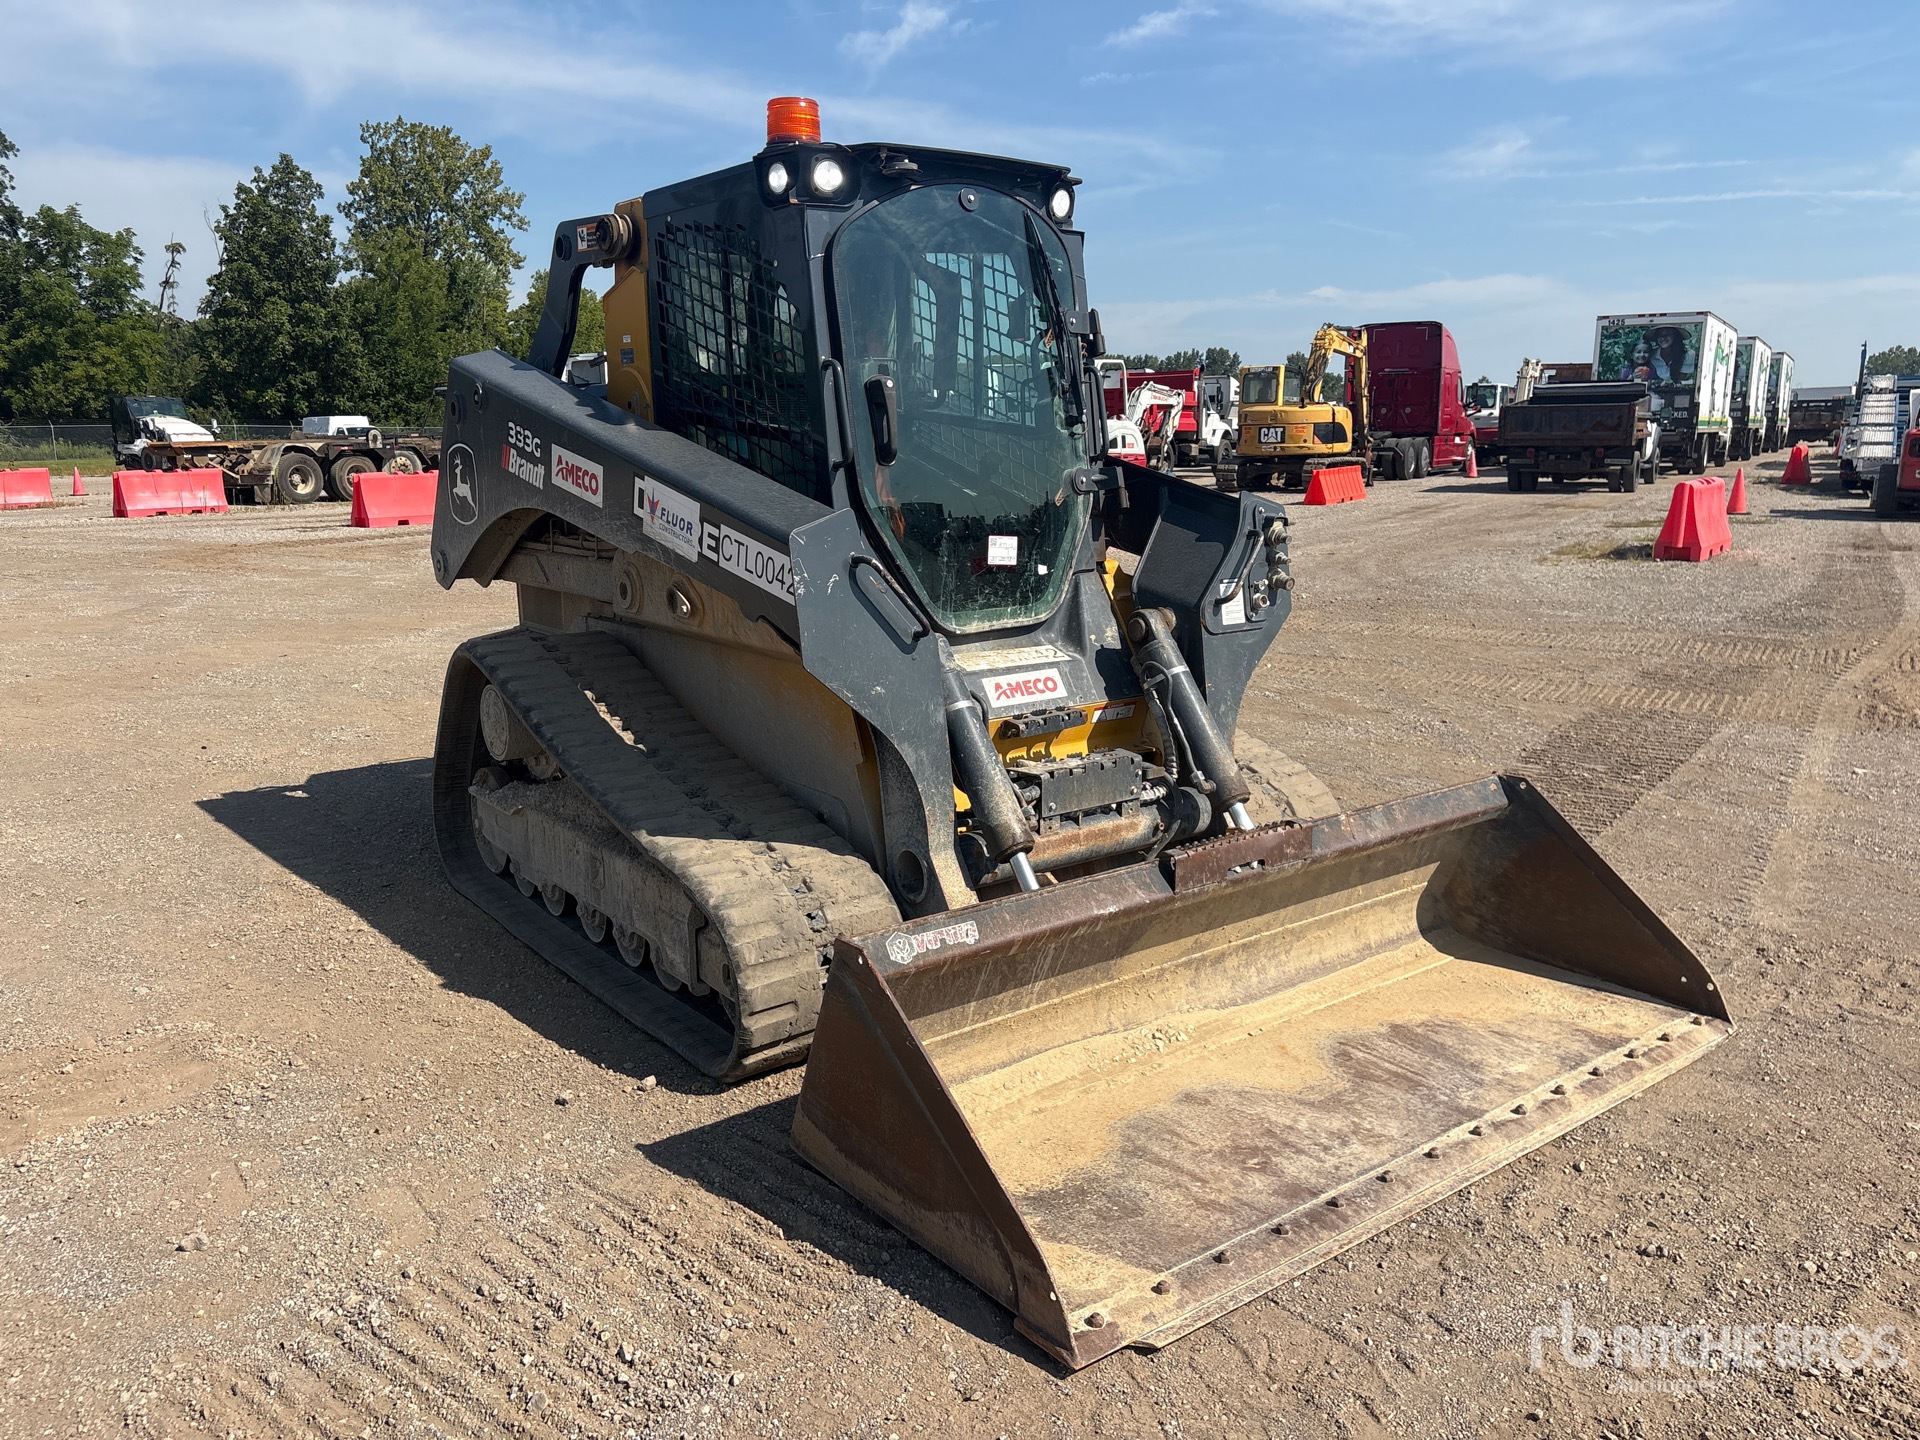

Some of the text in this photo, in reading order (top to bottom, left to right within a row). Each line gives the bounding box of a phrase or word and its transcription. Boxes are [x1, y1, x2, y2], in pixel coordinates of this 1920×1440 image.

[507, 421, 541, 458] 333G
[1260, 427, 1284, 443] CAT
[508, 447, 545, 490] Brandt
[554, 454, 600, 496] AMECO
[659, 522, 694, 548] CONSTRUCTORS
[660, 506, 694, 537] FLUOR
[994, 677, 1059, 701] AMECO
